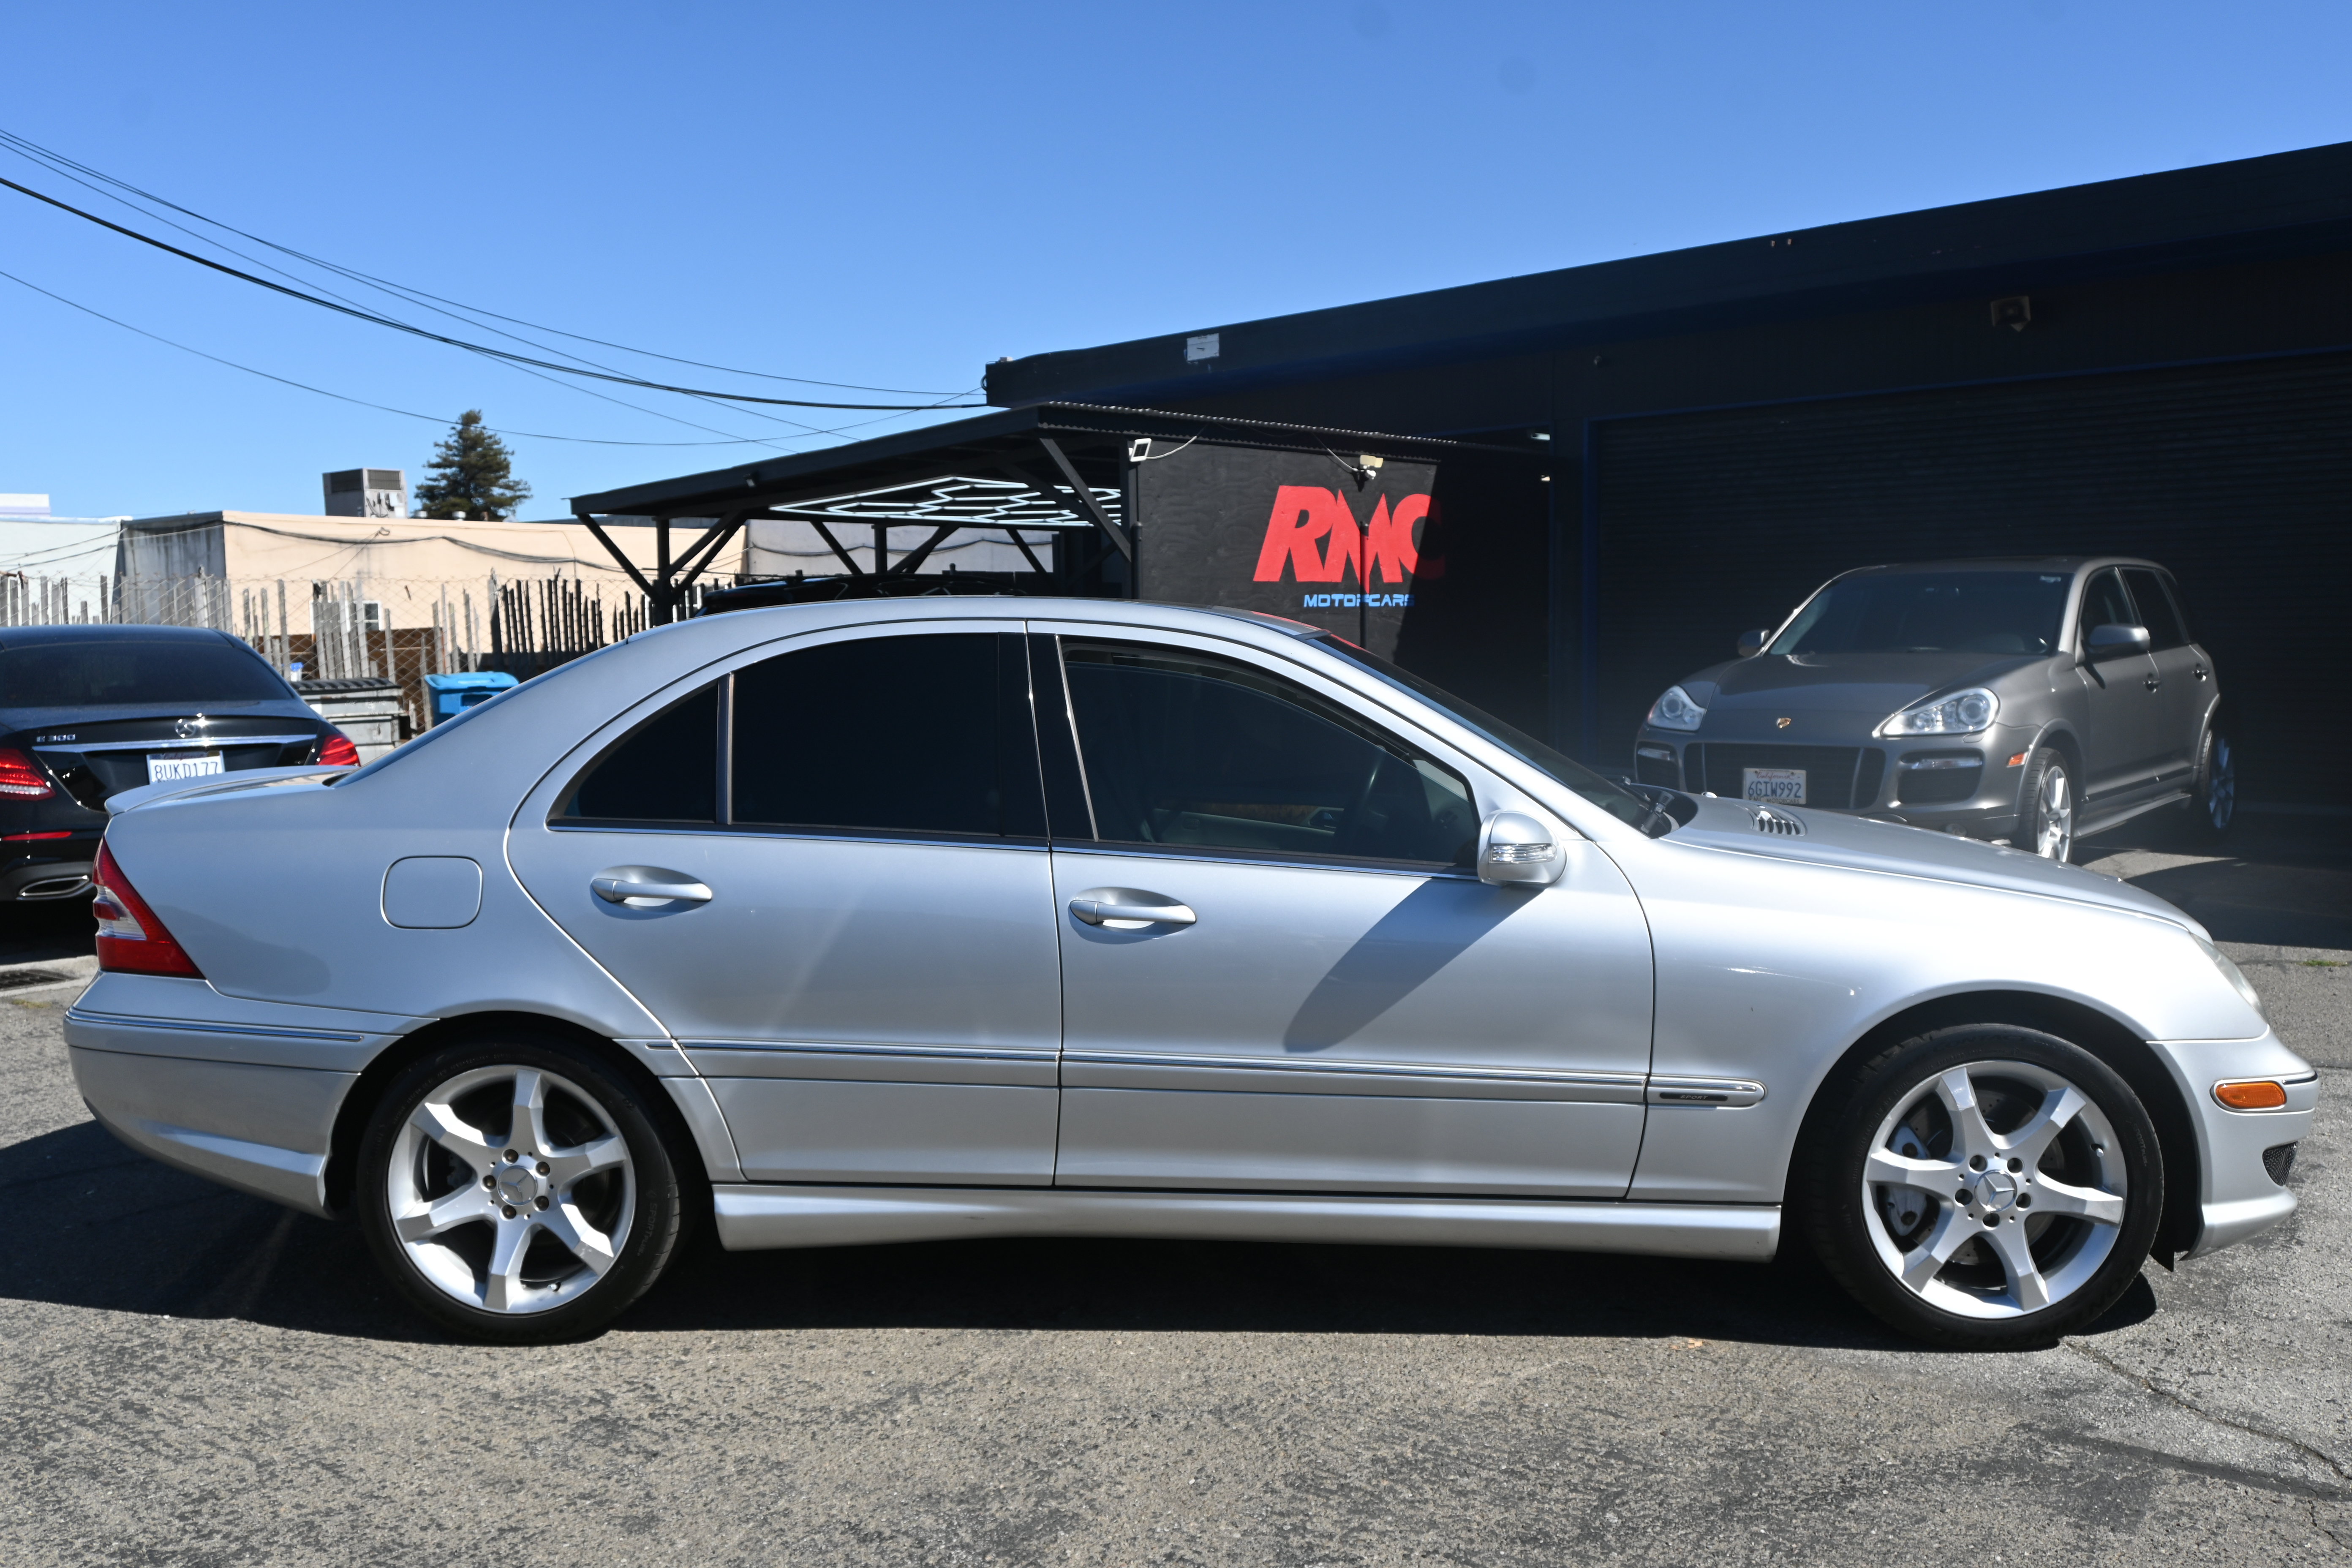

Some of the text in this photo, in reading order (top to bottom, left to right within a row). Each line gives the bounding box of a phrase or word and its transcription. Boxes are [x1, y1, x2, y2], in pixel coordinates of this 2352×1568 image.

[1253, 485, 1446, 594] RMC
[1304, 593, 1414, 607] MOTORCARS
[155, 762, 218, 780] 8UKD177
[1756, 772, 1794, 781] California
[1748, 780, 1802, 798] 6GIW992
